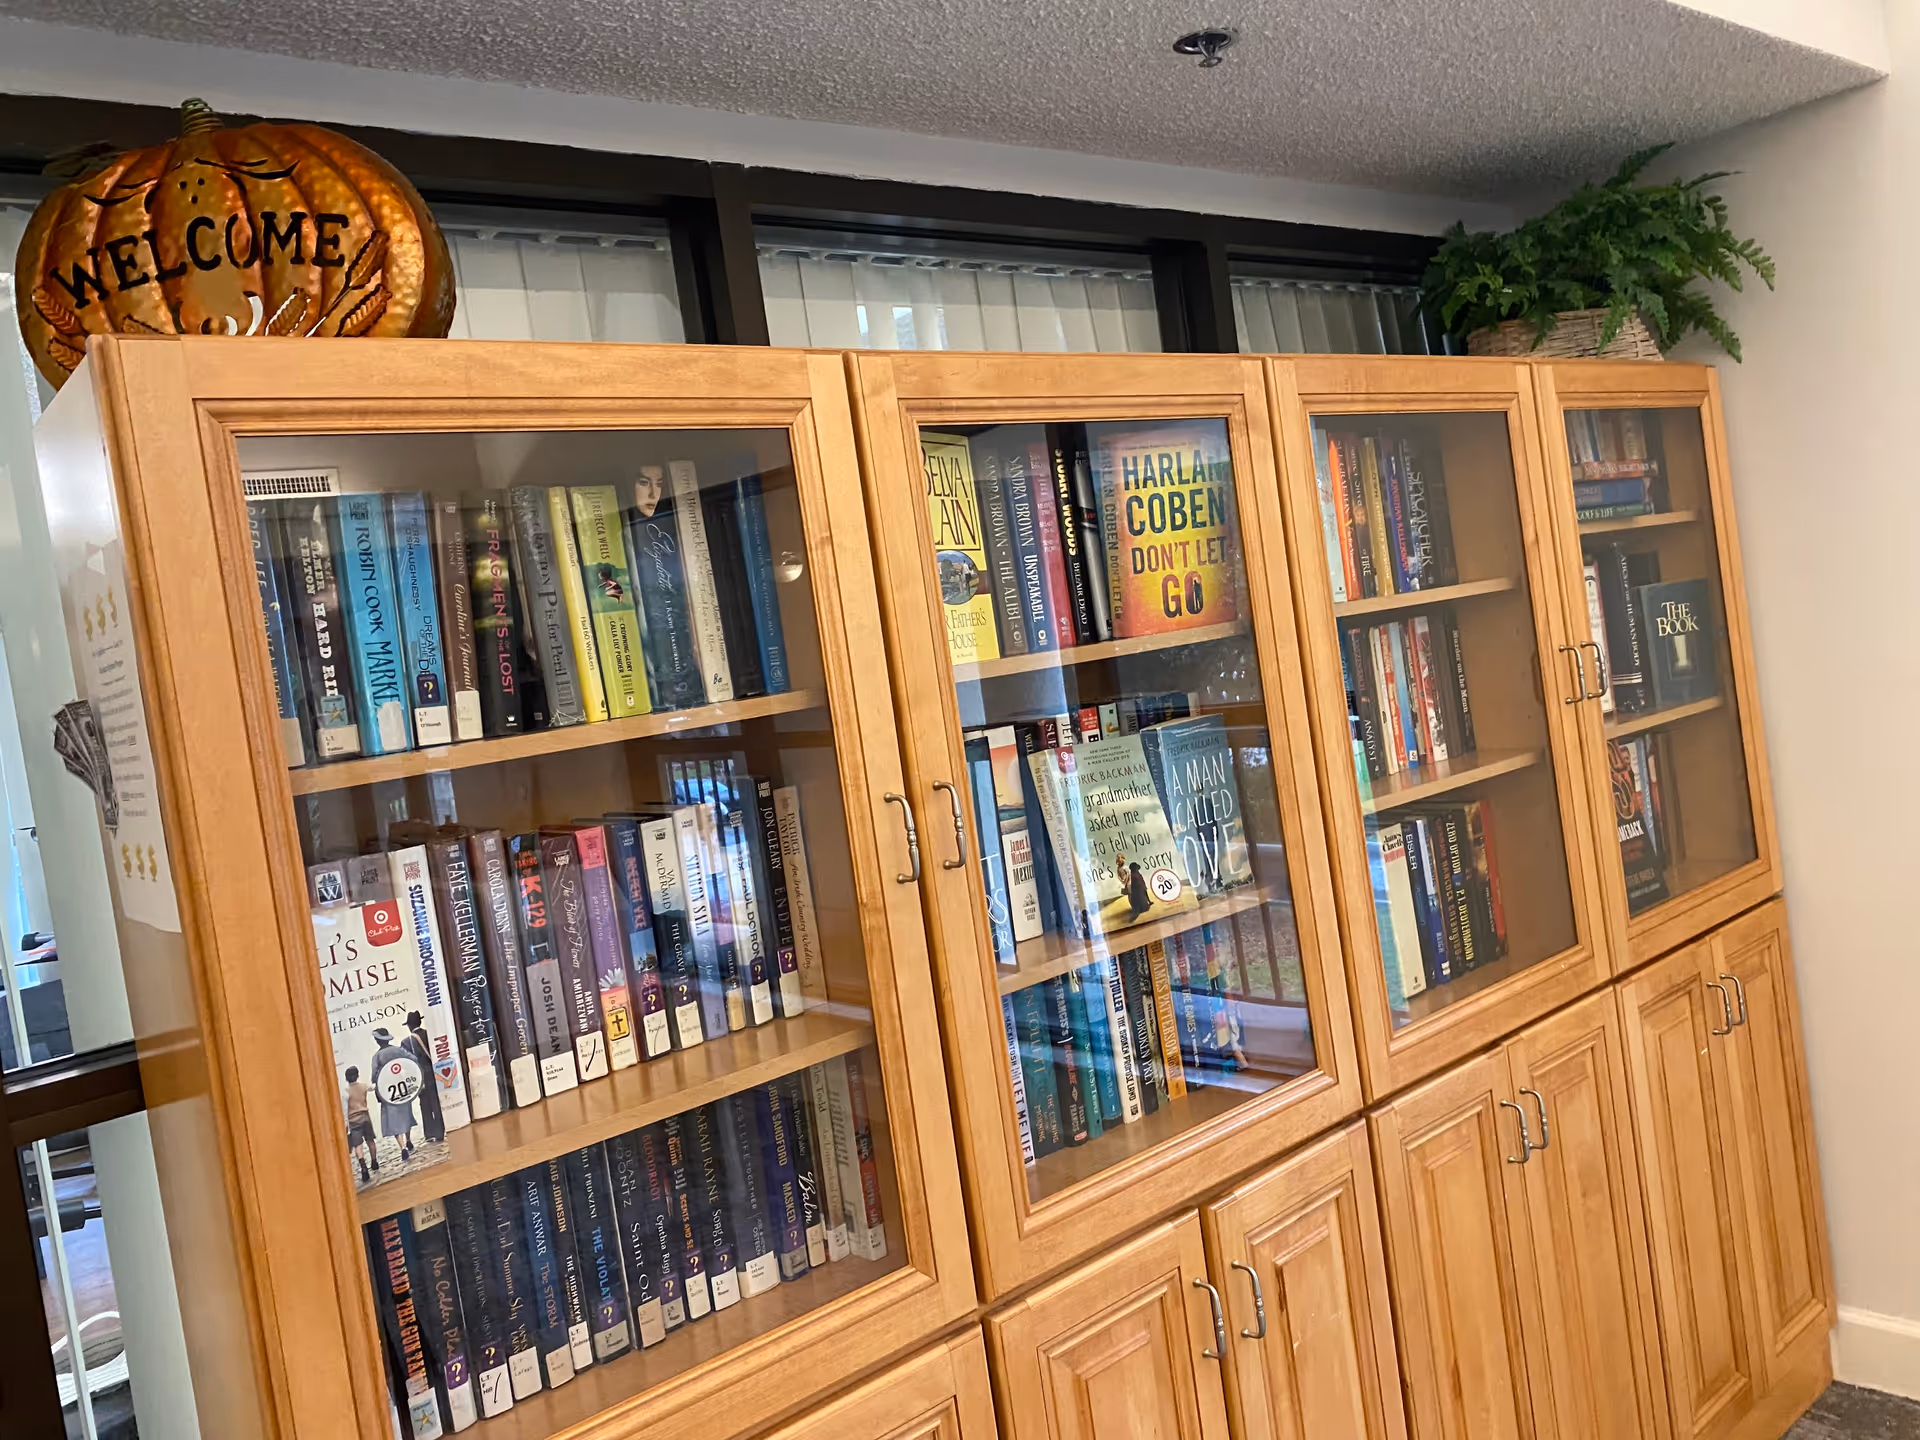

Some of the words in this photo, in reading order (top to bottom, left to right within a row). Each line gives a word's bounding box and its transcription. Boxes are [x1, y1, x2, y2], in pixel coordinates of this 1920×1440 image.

[50, 211, 350, 309] WELCOME
[984, 455, 1003, 500] SANDRA
[1007, 455, 1027, 501] SANDRA
[1121, 450, 1225, 491] HARLAN
[991, 502, 1009, 548] BROWN
[1014, 503, 1036, 548] BROWN
[1102, 503, 1119, 551] COBEN
[1125, 486, 1228, 537] COBEN
[1409, 471, 1434, 567] SPYCATCHER
[355, 527, 377, 582] ROBIN
[598, 537, 611, 560] WELLS
[646, 523, 677, 593] Elizabeth
[1131, 541, 1192, 575] DON'T
[1197, 536, 1228, 566] LET
[1363, 556, 1372, 577] FIRE
[486, 529, 508, 640] FRAGMENTS
[999, 559, 1016, 586] THE
[1023, 554, 1046, 623] UNSPEAKABLE
[364, 584, 384, 635] COOK
[453, 583, 472, 641] Caroline's
[537, 590, 557, 606] P
[1004, 587, 1021, 622] ALIBI
[1077, 599, 1088, 625] DEAD
[1161, 570, 1205, 619] GO
[1661, 601, 1691, 620] THE
[312, 602, 332, 659] HARD
[546, 609, 556, 619] is
[548, 621, 560, 641] for
[1627, 603, 1639, 639] HUMAN
[1656, 615, 1700, 637] BOOK
[422, 615, 437, 666] DREAMS
[583, 633, 591, 644] 60
[609, 621, 618, 639] CALLA
[615, 651, 626, 674] PONDER
[619, 623, 630, 651] CROWNING
[1632, 640, 1641, 667] BODY
[499, 652, 516, 696] LOST
[549, 646, 568, 677] Peril
[624, 651, 633, 673] GLORY
[1461, 689, 1469, 713] Menu
[1364, 719, 1377, 761] ANALYST
[1059, 772, 1097, 789] FREDRIK
[1099, 763, 1147, 781] BACKMAN
[1172, 764, 1184, 797] A
[1186, 752, 1226, 794] MAN
[760, 807, 774, 824] JON
[1065, 795, 1080, 817] my
[1083, 780, 1153, 813] grandmother
[1176, 788, 1233, 832] CALLED
[781, 815, 792, 857] TAYLOR
[786, 813, 801, 856] PATRICK
[1088, 809, 1120, 832] asked
[1123, 810, 1140, 824] me
[1446, 822, 1458, 845] ZERO
[765, 825, 781, 870] CLEARY
[1093, 839, 1106, 856] to
[1109, 831, 1128, 853] tell
[1131, 832, 1152, 853] you
[1182, 822, 1246, 889] OVE
[1406, 834, 1417, 870] EISLER
[1449, 845, 1462, 875] OPTION
[447, 862, 466, 899] FAYE
[486, 859, 503, 900] CAROLA
[655, 852, 673, 910] McDERMID
[667, 869, 678, 888] VAL
[1085, 862, 1114, 884] she's
[1142, 850, 1173, 874] sorry
[409, 885, 428, 937] SUZANNE
[491, 900, 511, 933] DUNN
[672, 922, 681, 937] THE
[692, 905, 709, 937] SALA
[454, 899, 480, 974] KELLERMAN
[503, 938, 515, 963] The
[747, 906, 762, 959] DOIRON
[1459, 904, 1475, 961] DEUTERMANN
[417, 937, 442, 1008] BROCKMANN
[674, 940, 687, 973] GRAVE
[1151, 956, 1167, 992] JAMES
[507, 963, 522, 1015] Improper
[541, 978, 555, 1012] JOSH
[572, 978, 589, 1033] AMIRREZVANI
[583, 991, 594, 1016] ANITA
[1182, 988, 1192, 1004] THE
[333, 1021, 347, 1035] H.
[349, 1002, 408, 1029] BALSON
[547, 1016, 562, 1053] DEAN
[1157, 994, 1178, 1057] PATTERSON
[1185, 1005, 1196, 1034] GAMES
[1004, 1013, 1018, 1066] MACKINTOSH
[1026, 1010, 1046, 1075] FOLLETT
[1107, 979, 1124, 1014] MULLER
[1116, 1015, 1126, 1028] THE
[1127, 1084, 1137, 1102] LAND
[1135, 1018, 1151, 1060] BROKEN
[1142, 1061, 1156, 1087] PREY
[768, 1084, 781, 1112] JOHN
[1014, 1080, 1025, 1106] LET
[1017, 1109, 1029, 1129] ME
[1033, 1104, 1046, 1143] MORNING
[1070, 1103, 1081, 1133] FRANCIS
[1078, 1105, 1087, 1124] FELIX
[667, 1137, 678, 1167] Quinn
[772, 1114, 788, 1167] SANDFORD
[527, 1181, 541, 1214] ARIF
[703, 1157, 721, 1205] RAYNE
[798, 1171, 813, 1225] Balm
[586, 1173, 598, 1219] PRONZINI
[593, 1227, 605, 1252] THE
[679, 1194, 690, 1222] SCENTS
[781, 1181, 797, 1224] MASKED
[380, 1218, 402, 1246] MAX
[532, 1212, 547, 1256] ANWAR
[554, 1186, 567, 1233] JOHNSON
[565, 1255, 574, 1271] THE
[630, 1222, 644, 1267] Saint
[656, 1215, 668, 1251] Cynthia
[385, 1249, 412, 1295] BRAND
[539, 1262, 549, 1285] The
[396, 1297, 416, 1324] THE
[541, 1284, 558, 1328] STORM
[401, 1325, 422, 1354] GUN
